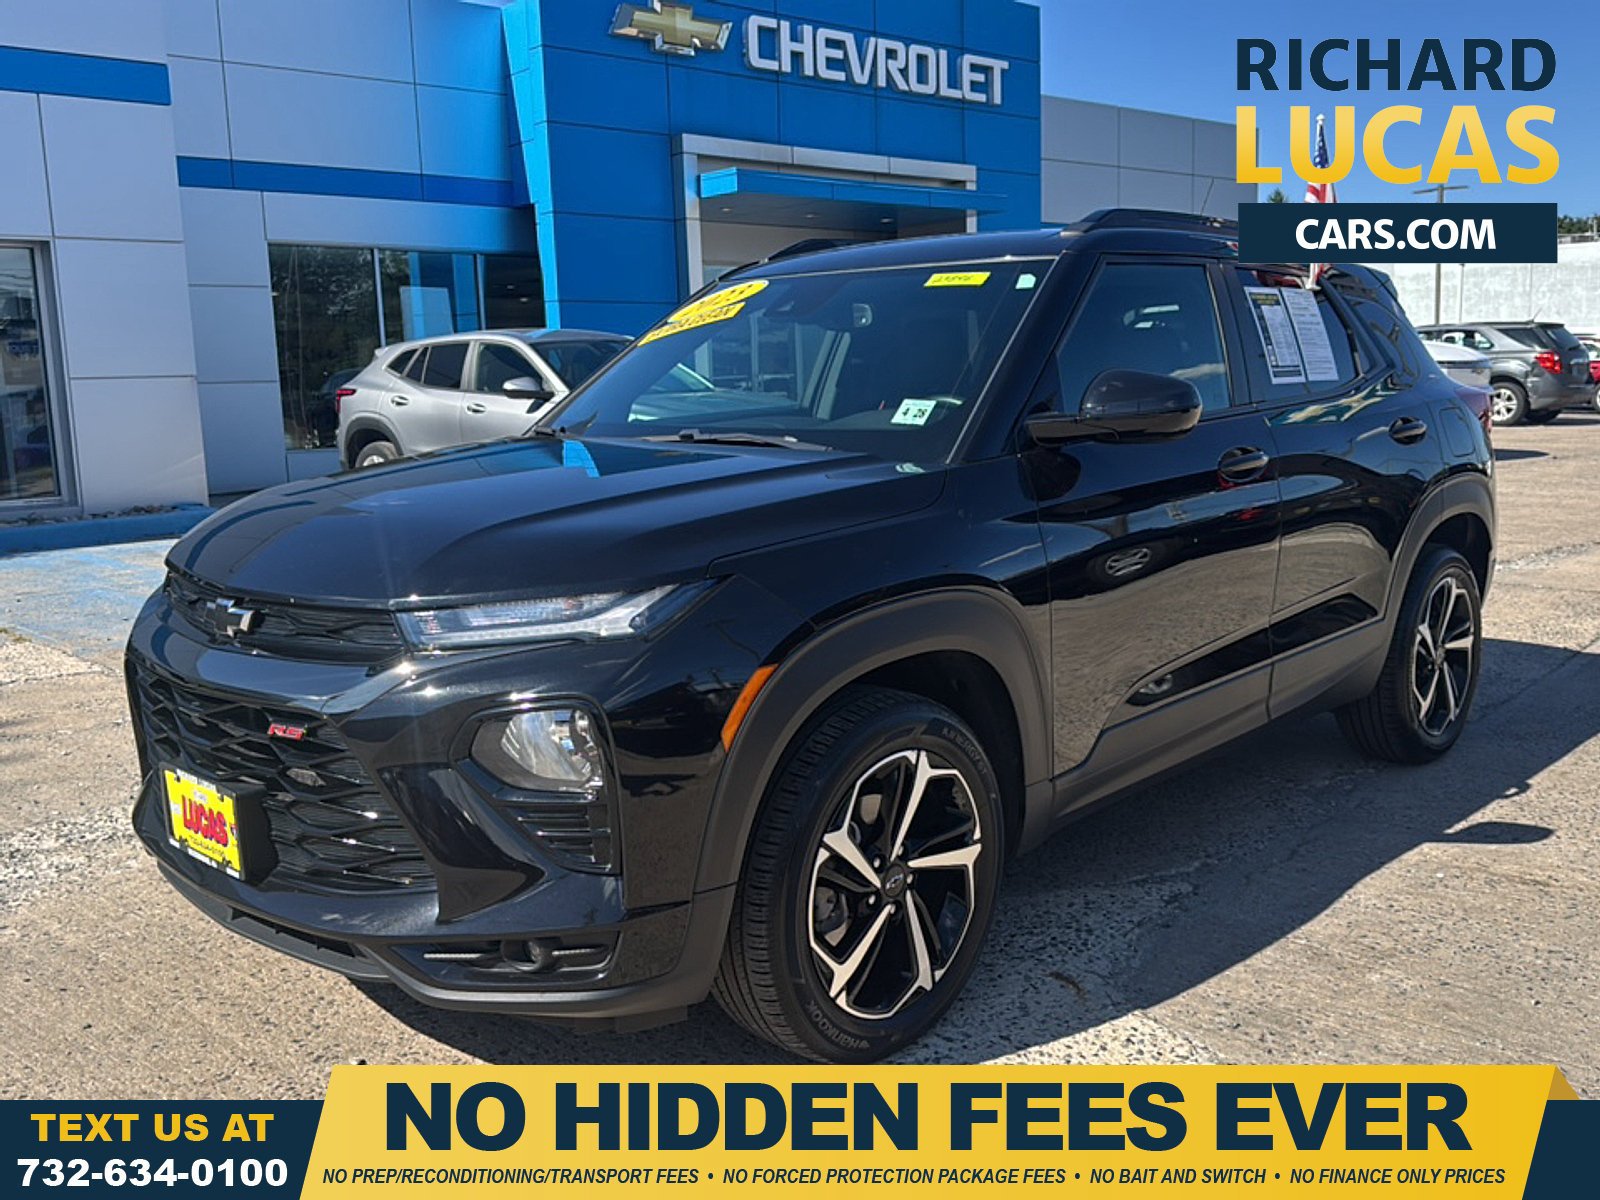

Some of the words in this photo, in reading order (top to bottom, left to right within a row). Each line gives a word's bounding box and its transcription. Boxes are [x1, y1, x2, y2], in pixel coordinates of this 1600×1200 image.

[742, 14, 1009, 105] CHEVROLET
[267, 723, 304, 740] RS
[182, 795, 229, 847] LUCAS
